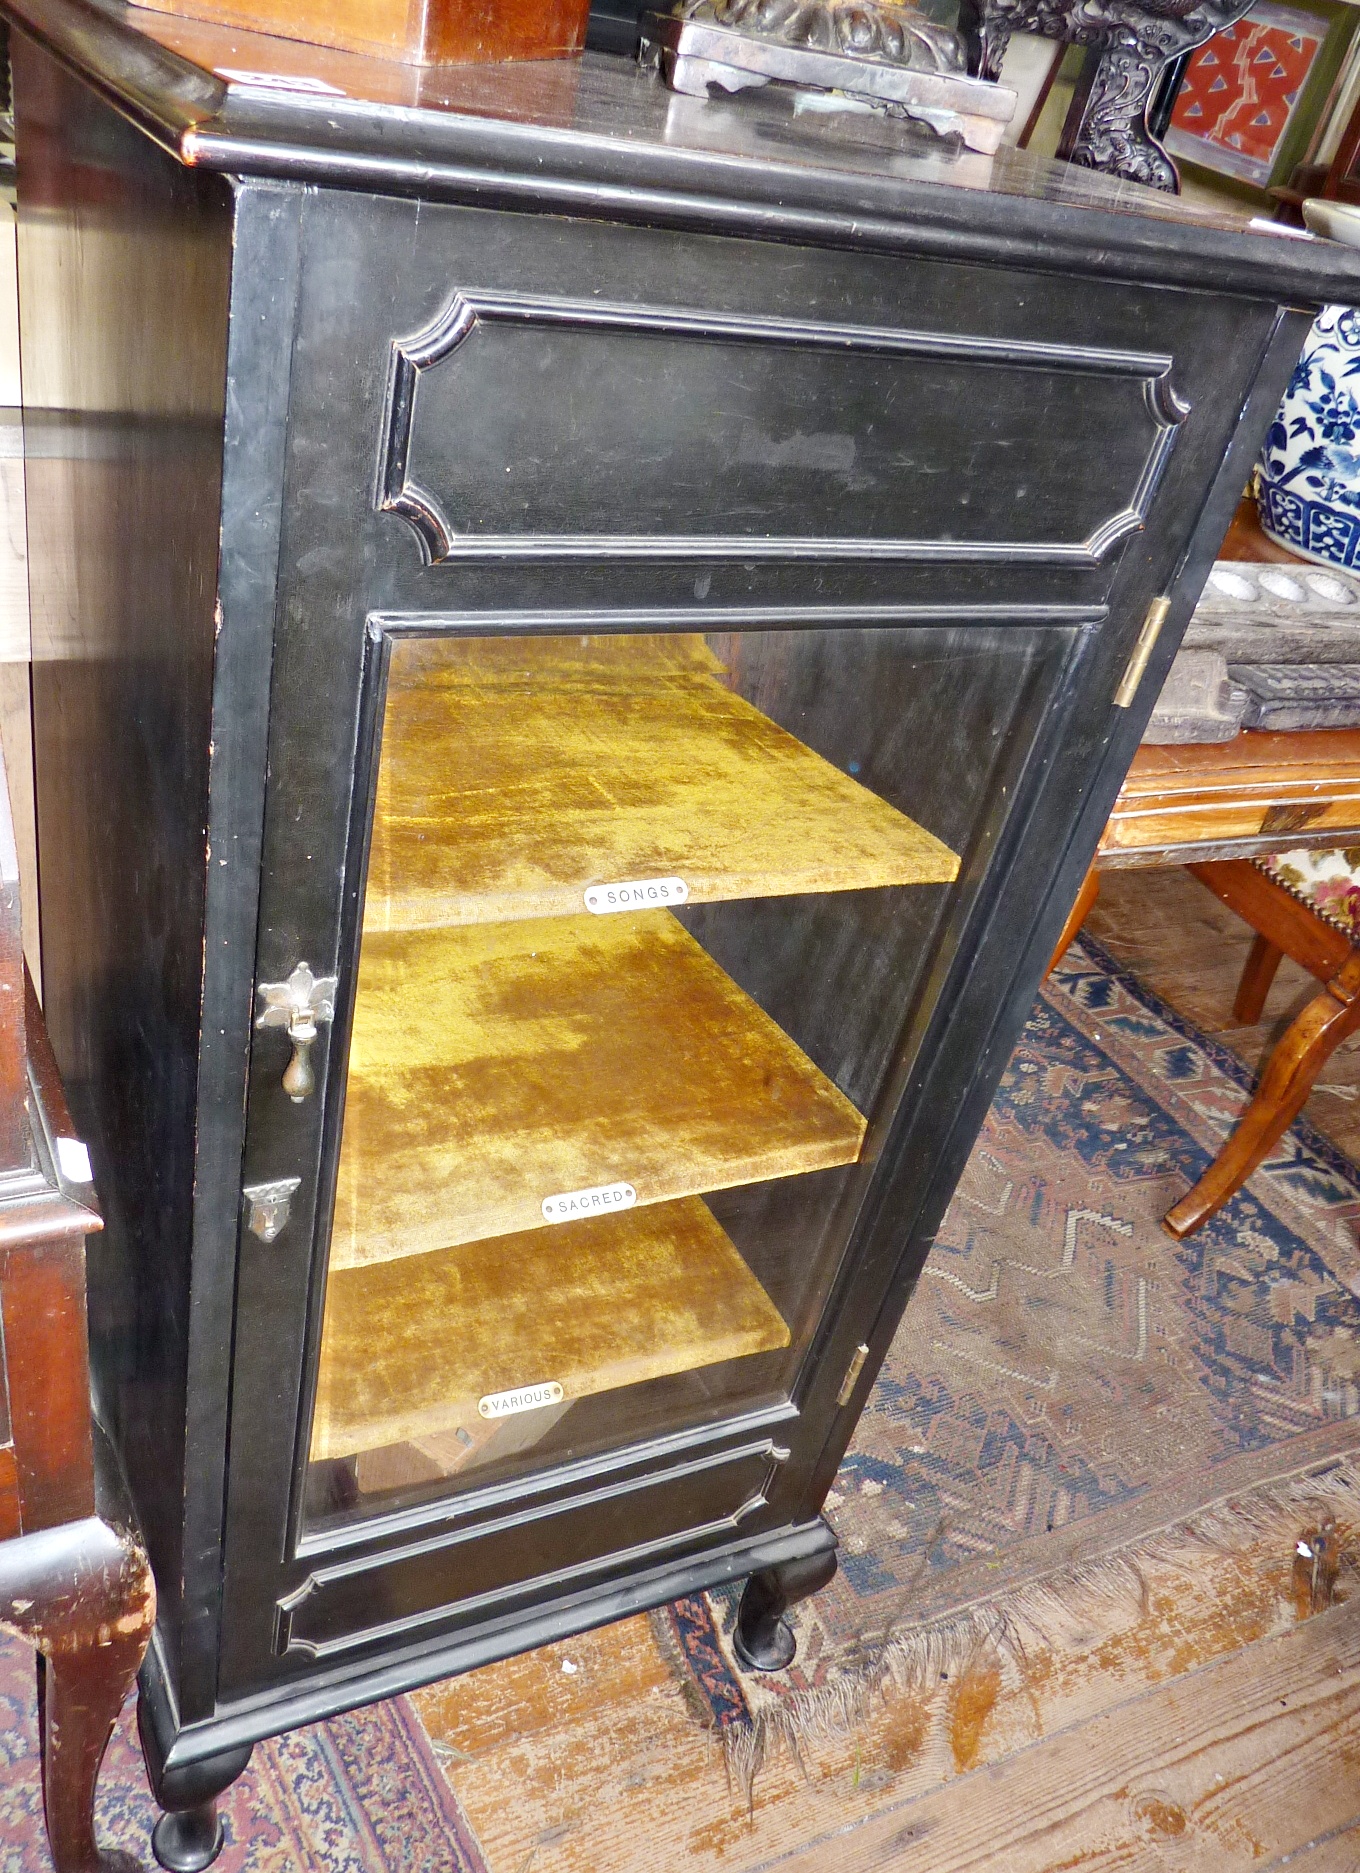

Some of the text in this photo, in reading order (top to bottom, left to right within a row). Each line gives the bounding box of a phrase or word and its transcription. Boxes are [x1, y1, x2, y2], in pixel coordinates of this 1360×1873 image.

[607, 885, 669, 904] SONGS
[558, 1191, 623, 1212] SACRED
[491, 1389, 551, 1411] VARIOUS
